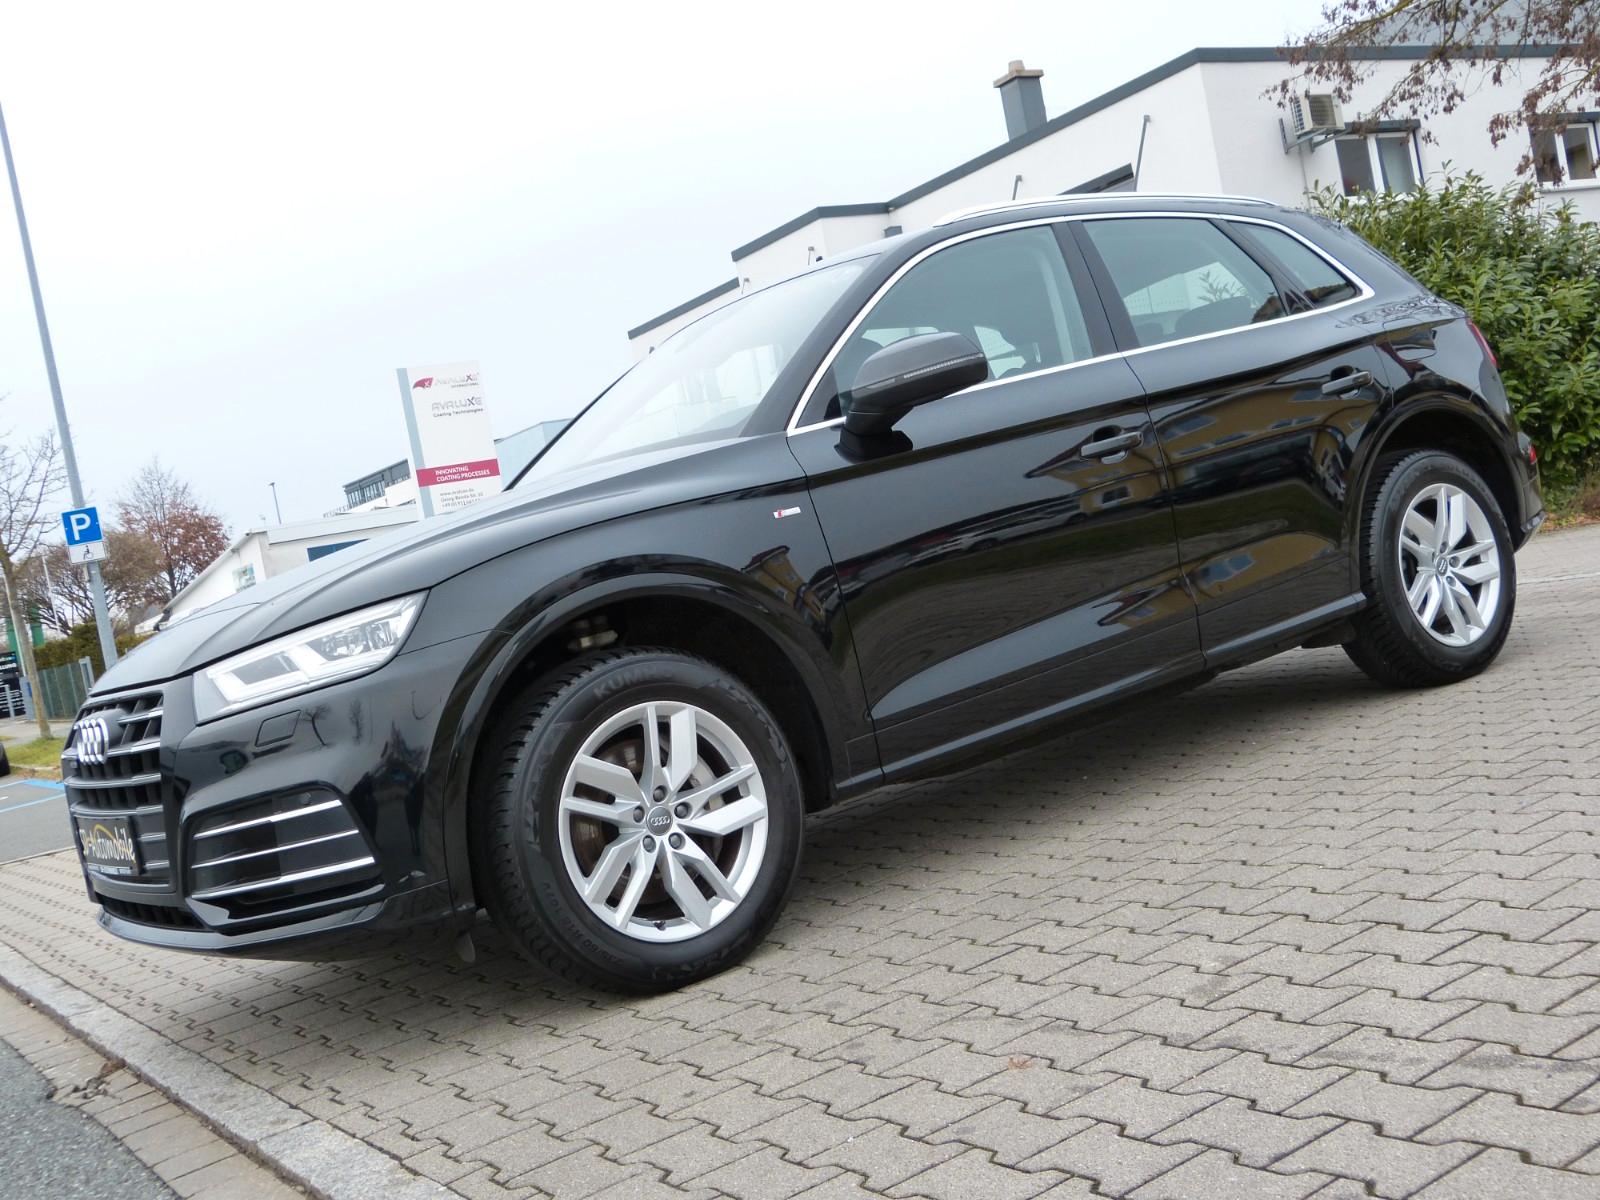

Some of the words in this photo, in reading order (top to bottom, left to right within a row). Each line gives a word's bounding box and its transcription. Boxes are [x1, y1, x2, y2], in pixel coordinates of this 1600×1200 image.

[432, 396, 482, 411] AVALUXE
[435, 466, 469, 476] INNOVATING
[436, 473, 461, 482] COATING
[461, 469, 490, 480] PROCESSES
[70, 513, 91, 541] P
